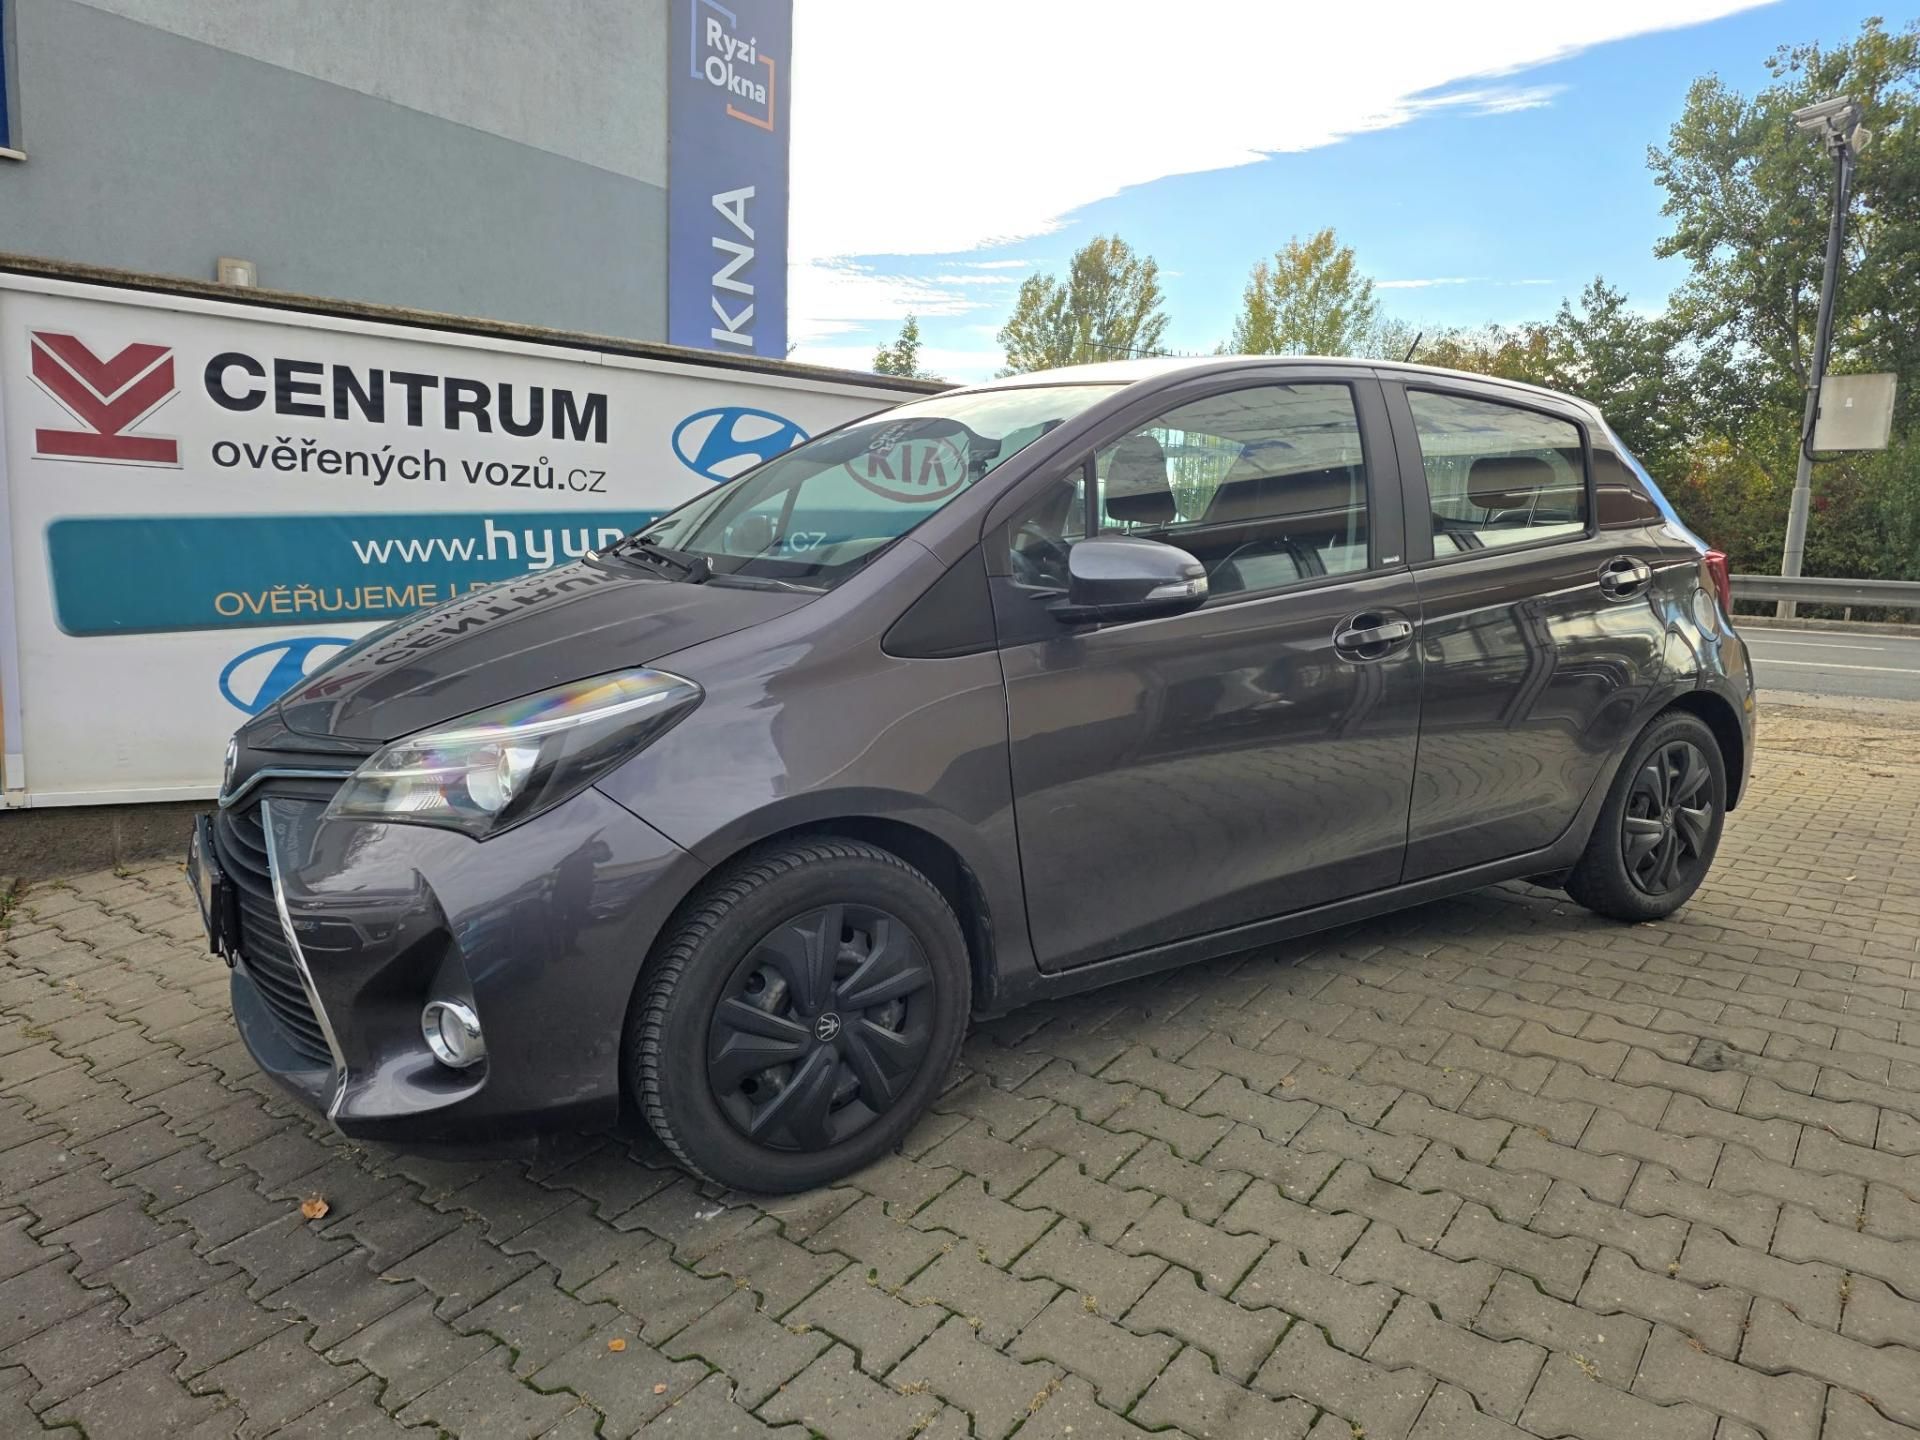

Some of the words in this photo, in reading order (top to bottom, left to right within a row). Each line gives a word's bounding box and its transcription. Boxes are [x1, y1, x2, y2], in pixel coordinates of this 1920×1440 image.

[705, 55, 766, 105] Okna
[204, 352, 608, 444] CENTRUM
[211, 436, 447, 486] ověřených
[867, 444, 947, 486] KIA
[214, 583, 439, 616] OVĚŘUJEME
